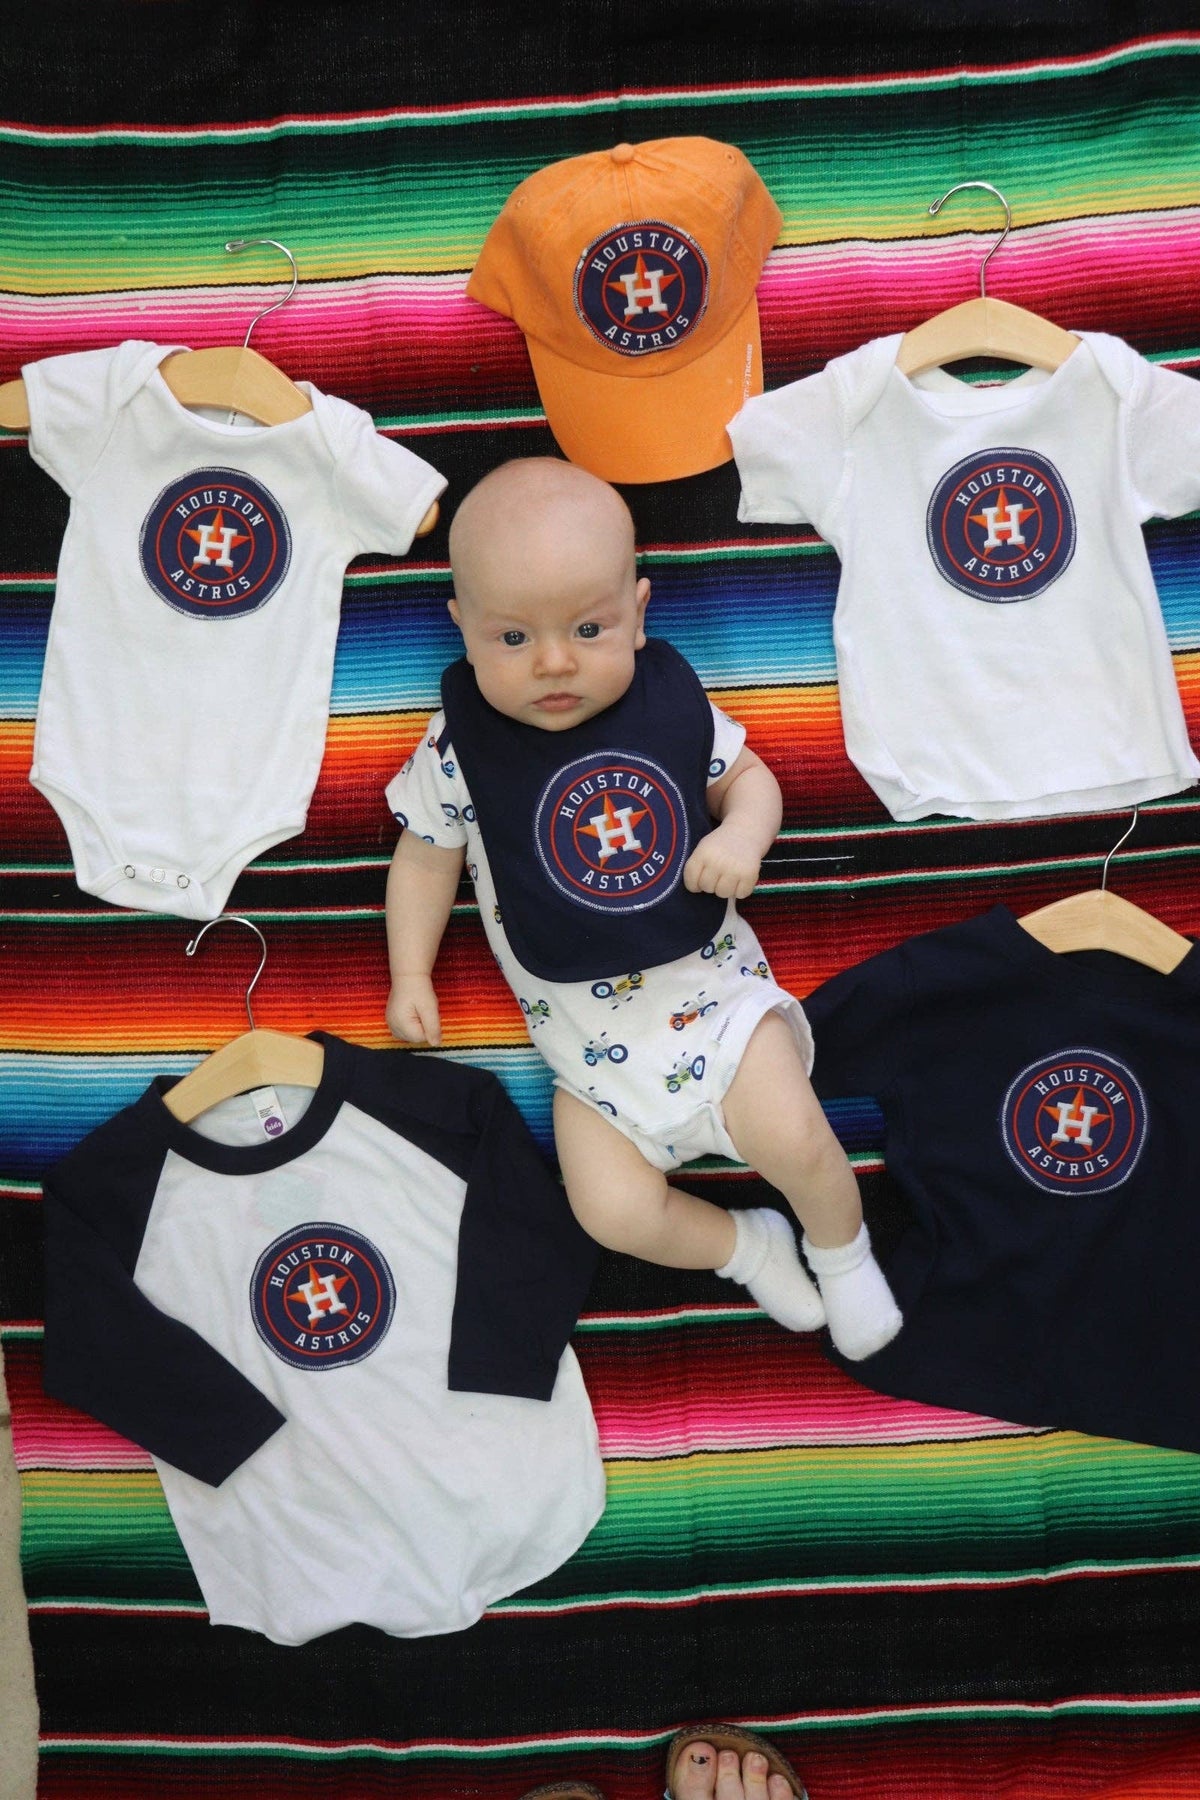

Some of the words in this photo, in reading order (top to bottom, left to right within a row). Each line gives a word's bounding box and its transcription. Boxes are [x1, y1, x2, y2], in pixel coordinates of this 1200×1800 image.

[591, 232, 689, 273] HOUSTON
[619, 269, 668, 315] H
[604, 314, 689, 348] ASTROS
[955, 468, 1047, 506] HOUSTON
[176, 490, 265, 527] HOUSTON
[981, 503, 1026, 548] H
[193, 524, 238, 568] H
[964, 548, 1046, 580] ASTROS
[170, 569, 251, 599] ASTROS
[560, 773, 653, 819] HOUSTON
[589, 806, 642, 858] H
[581, 851, 665, 890] ASTROS
[1034, 1069, 1125, 1105] HOUSTON
[1051, 1101, 1099, 1146] H
[1027, 1145, 1109, 1176] ASTROS
[270, 1244, 354, 1288] HOUSTON
[298, 1274, 348, 1321] H
[294, 1311, 371, 1350] ASTROS
